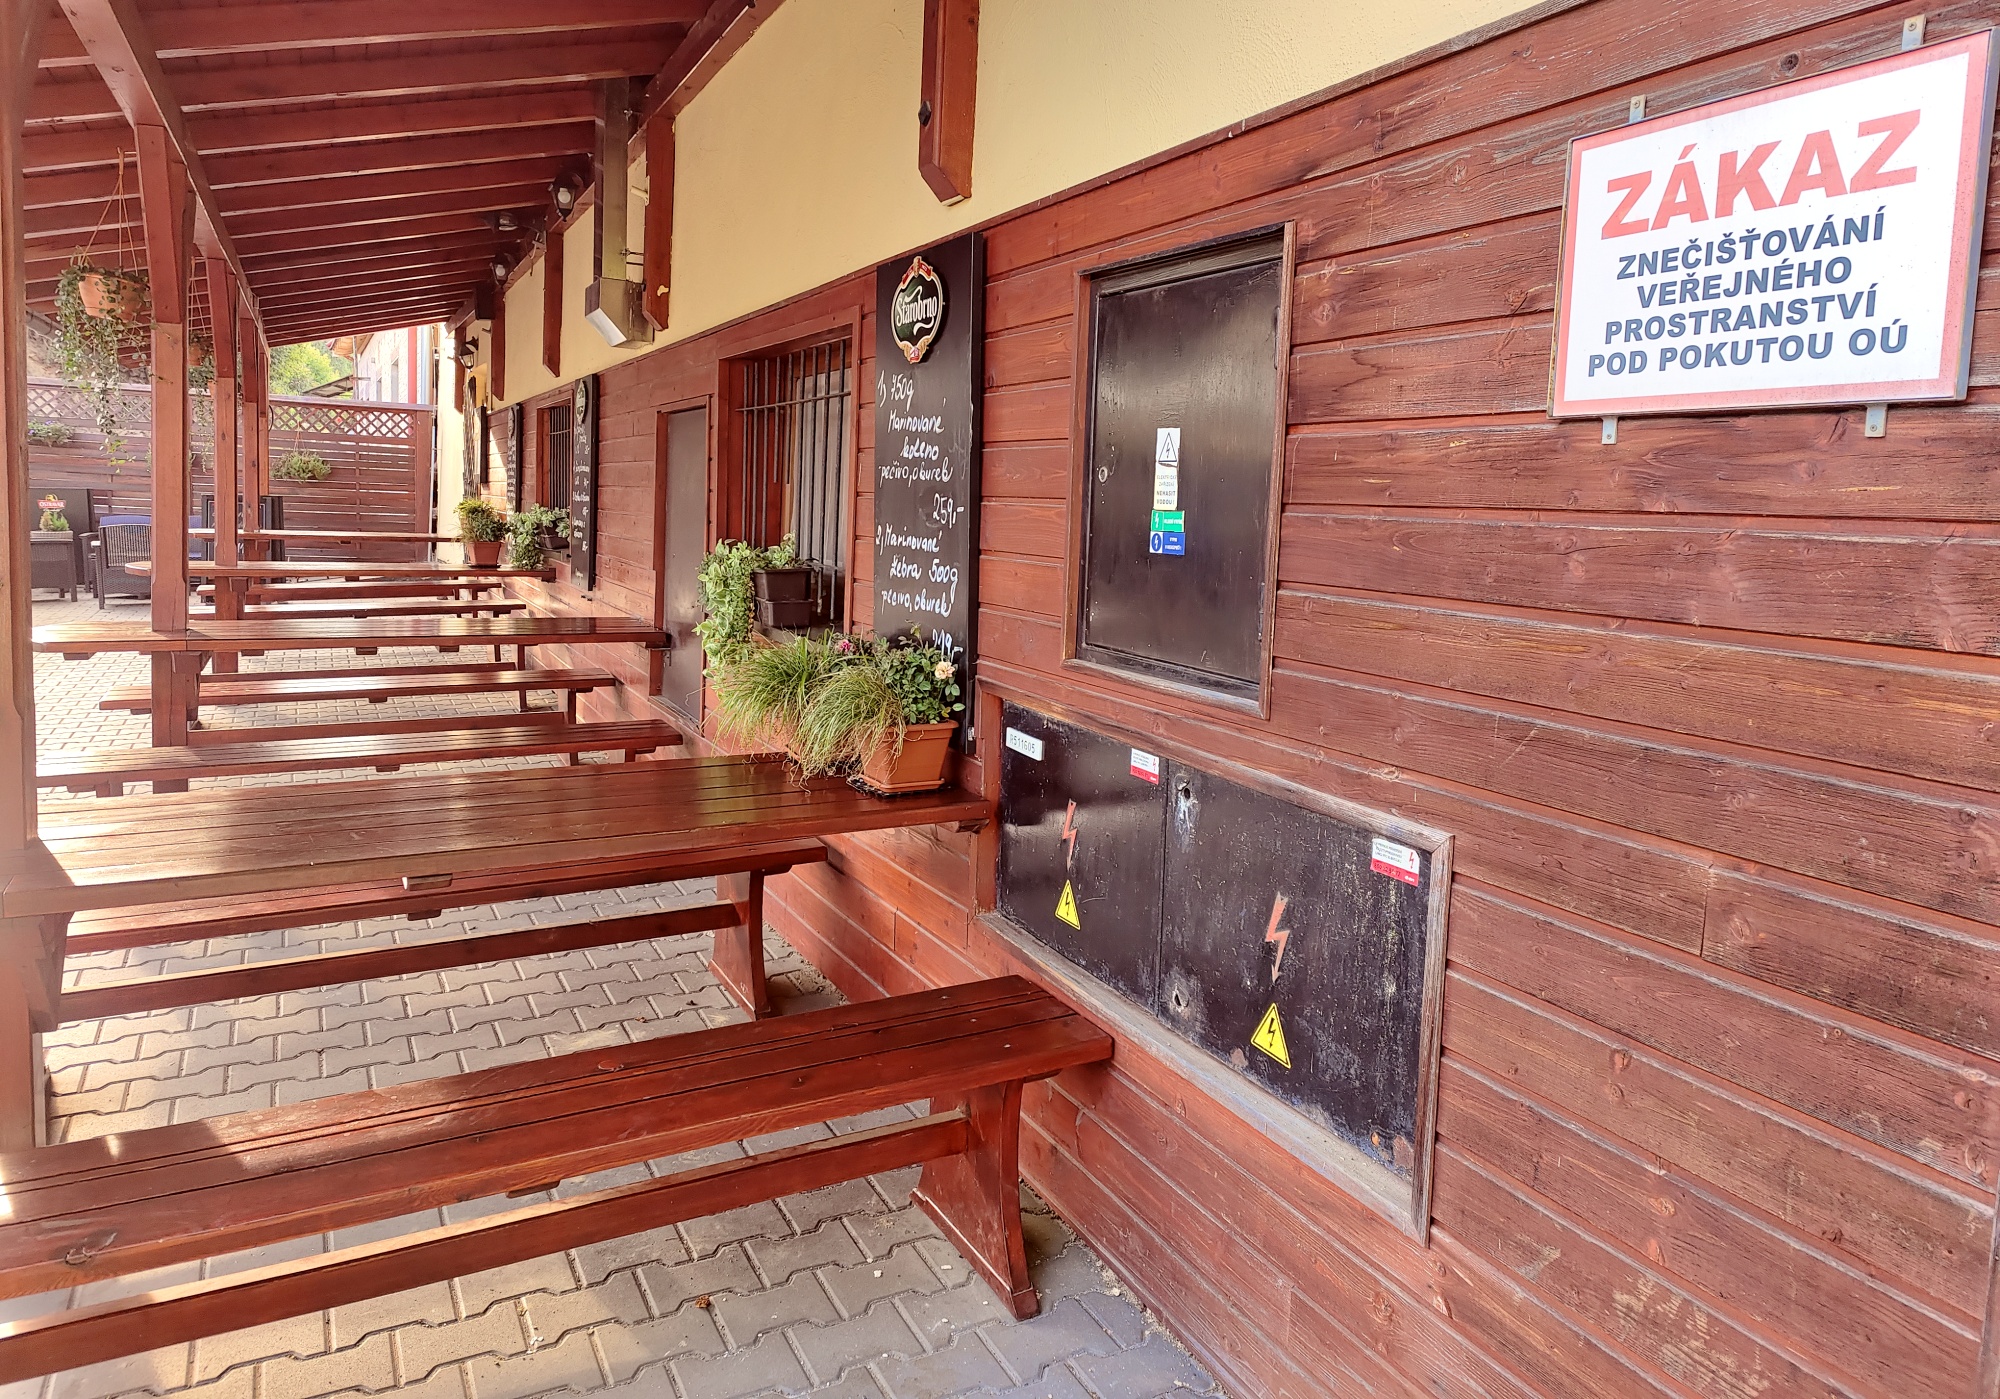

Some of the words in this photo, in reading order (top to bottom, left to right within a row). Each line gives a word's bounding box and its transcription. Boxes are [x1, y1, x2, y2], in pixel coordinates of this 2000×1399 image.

[1601, 109, 1921, 240] ZÁKAZ
[1616, 205, 1887, 280] ZNEČIŠŤOVÁNÍ
[896, 285, 938, 336] Starobrno
[1636, 256, 1852, 308] VEŘEJNÉHO
[1605, 283, 1878, 345] PROSTRANSTVÍ
[1588, 349, 1648, 378] POD
[1658, 331, 1834, 373] POKUTOU
[1847, 318, 1909, 359] OÚ
